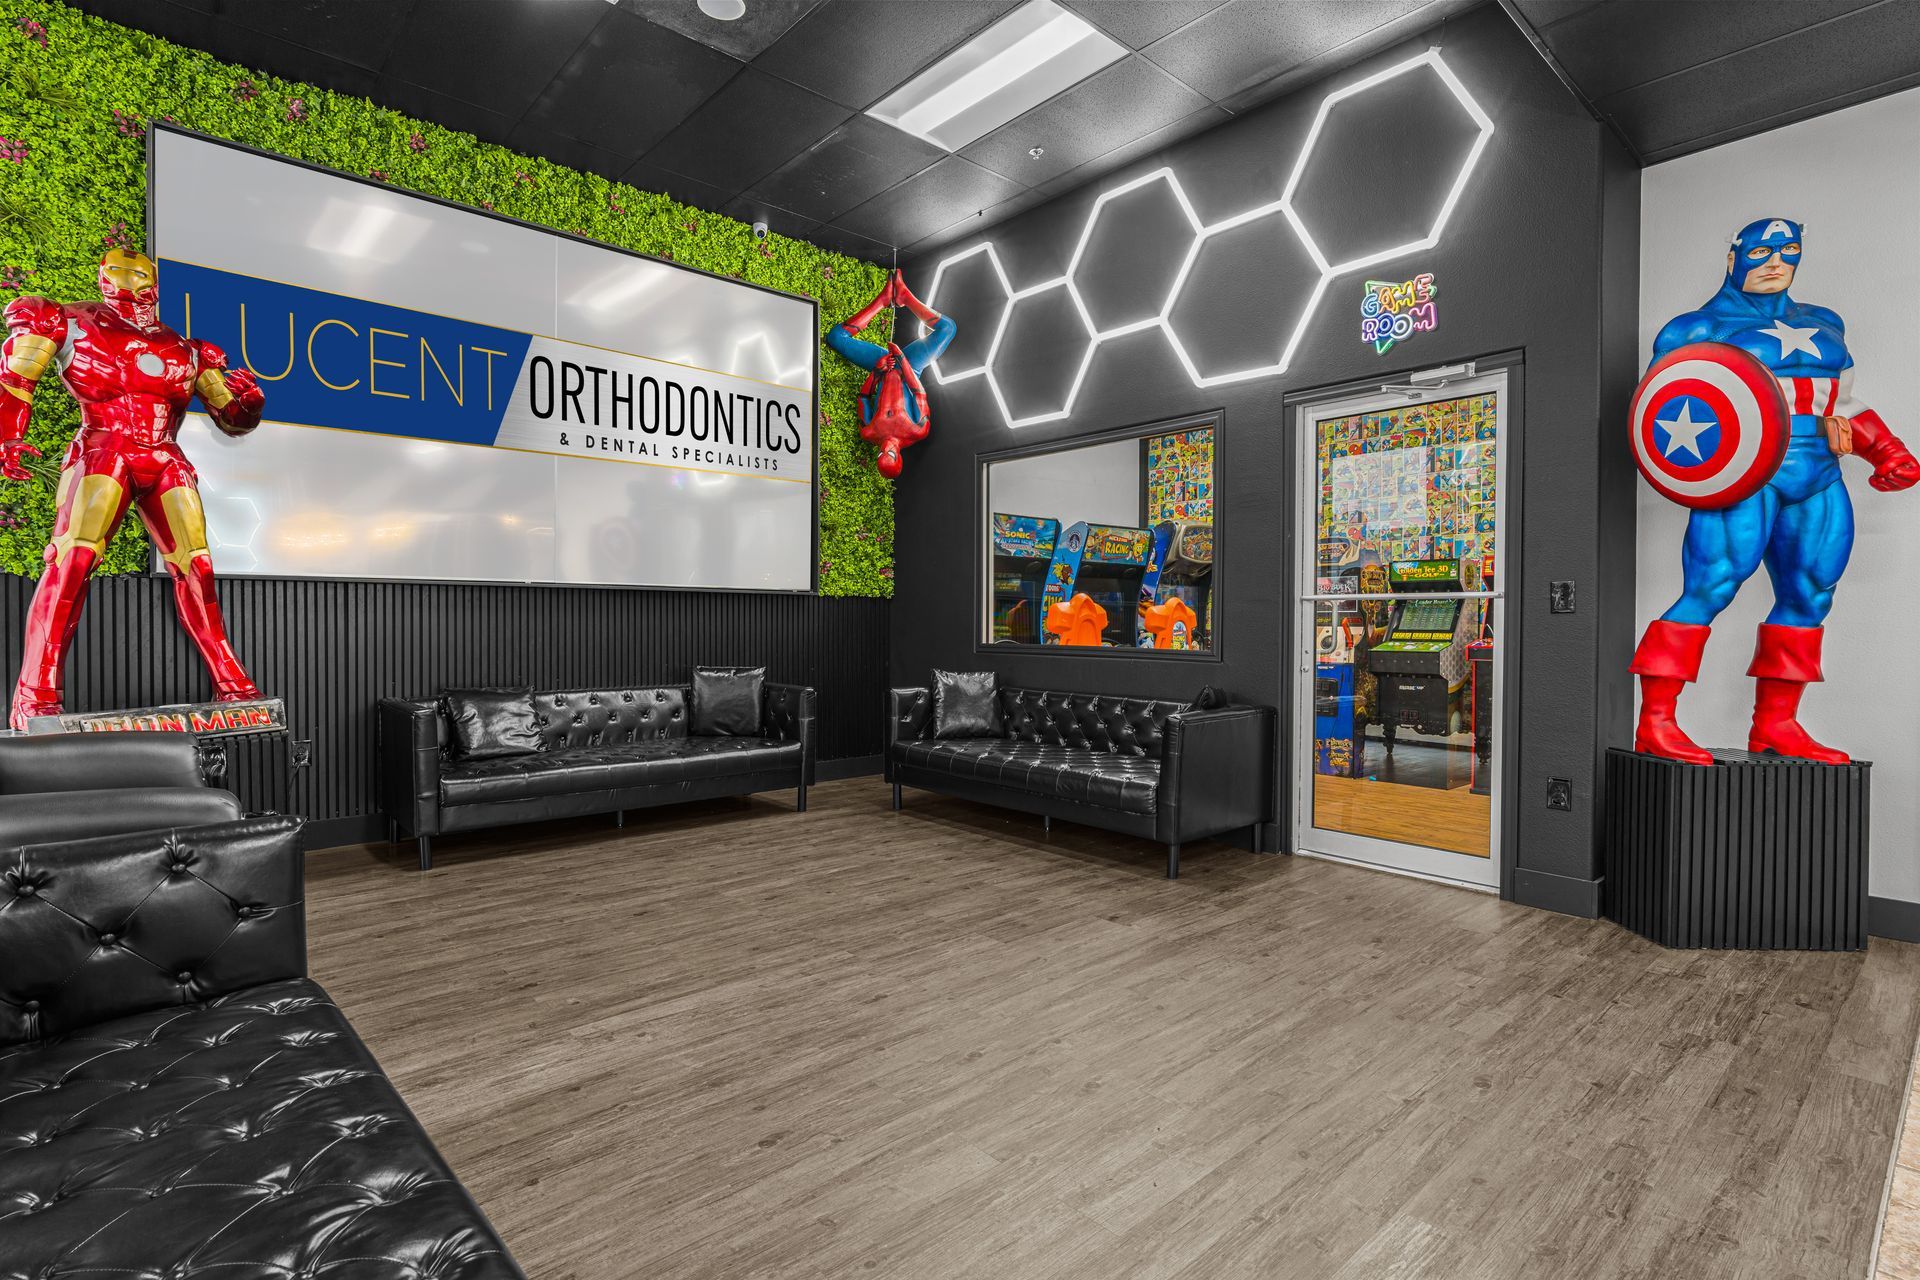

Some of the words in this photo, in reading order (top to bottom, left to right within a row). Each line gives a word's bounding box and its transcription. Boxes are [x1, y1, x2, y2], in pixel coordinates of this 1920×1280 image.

[1361, 273, 1434, 317] GAME
[1361, 302, 1437, 342] ROOM
[529, 355, 801, 454] ORTHODONTICS
[559, 432, 570, 446] &
[585, 434, 659, 457] DENTAL
[671, 446, 778, 471] SPECIALISTS
[1005, 530, 1031, 540] SONIC
[1105, 541, 1129, 554] RACING
[1398, 566, 1422, 575] Golden
[1438, 565, 1449, 573] 3D
[189, 706, 272, 733] MAN
